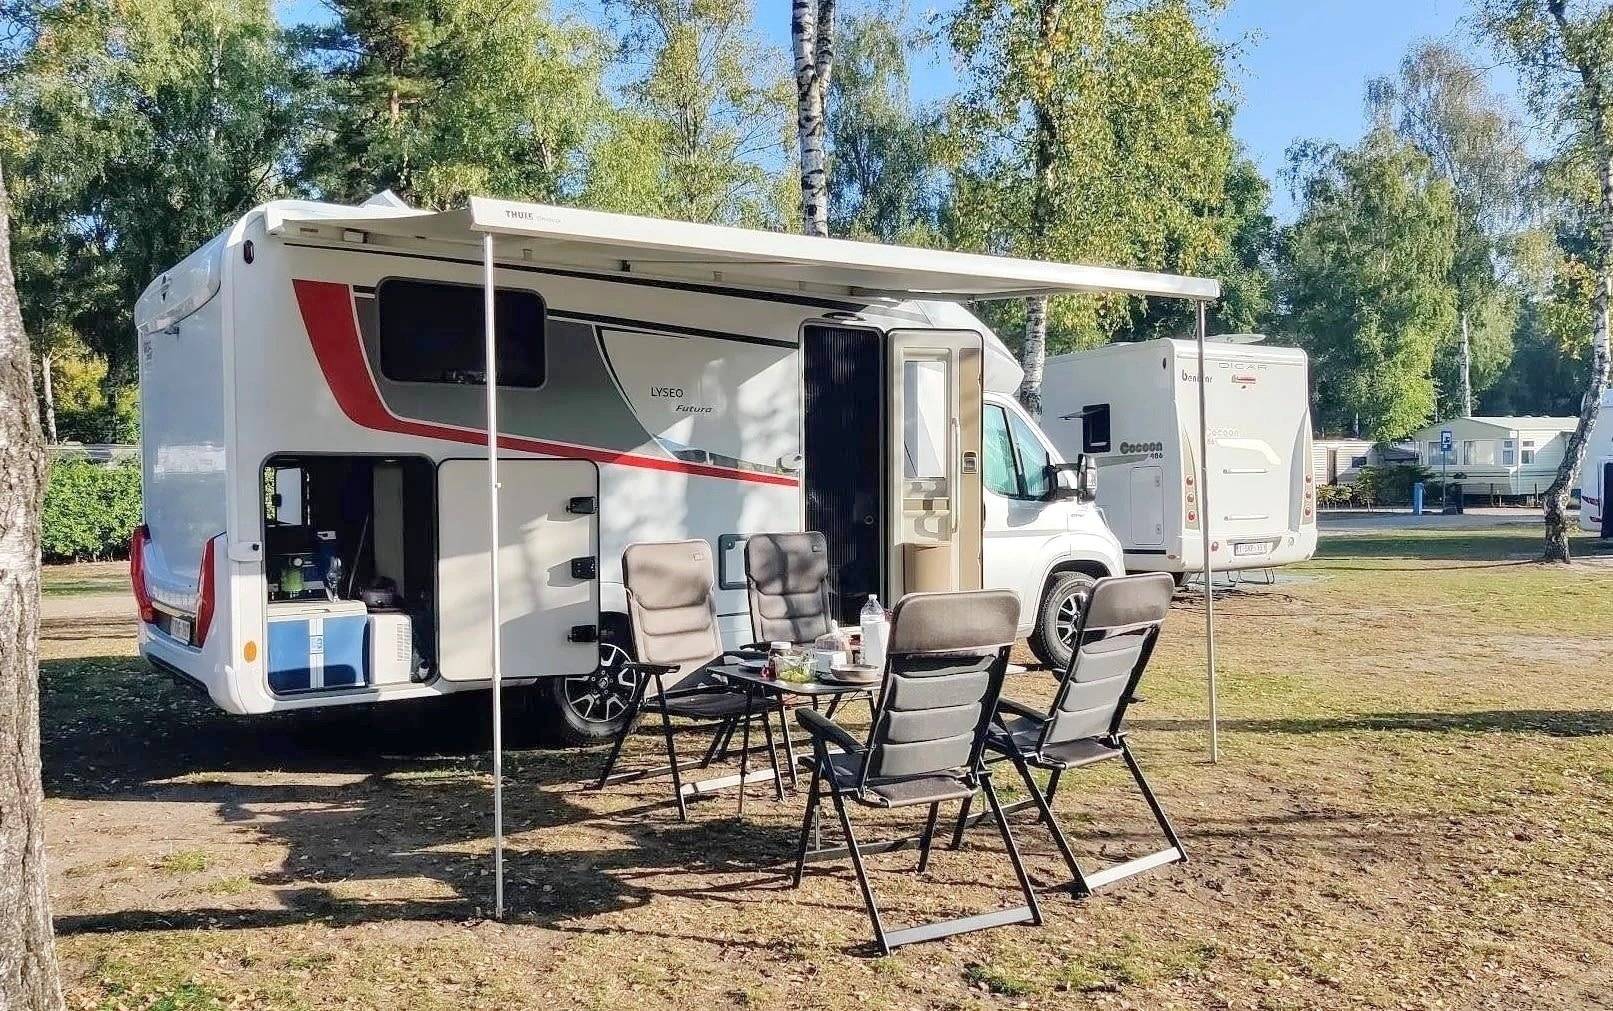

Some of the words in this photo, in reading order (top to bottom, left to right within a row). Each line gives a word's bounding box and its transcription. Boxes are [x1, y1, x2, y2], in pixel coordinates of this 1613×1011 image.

[505, 210, 534, 221] THULE
[650, 387, 684, 398] LYSEO
[675, 404, 713, 413] Futura
[1120, 441, 1163, 454] Cocoon
